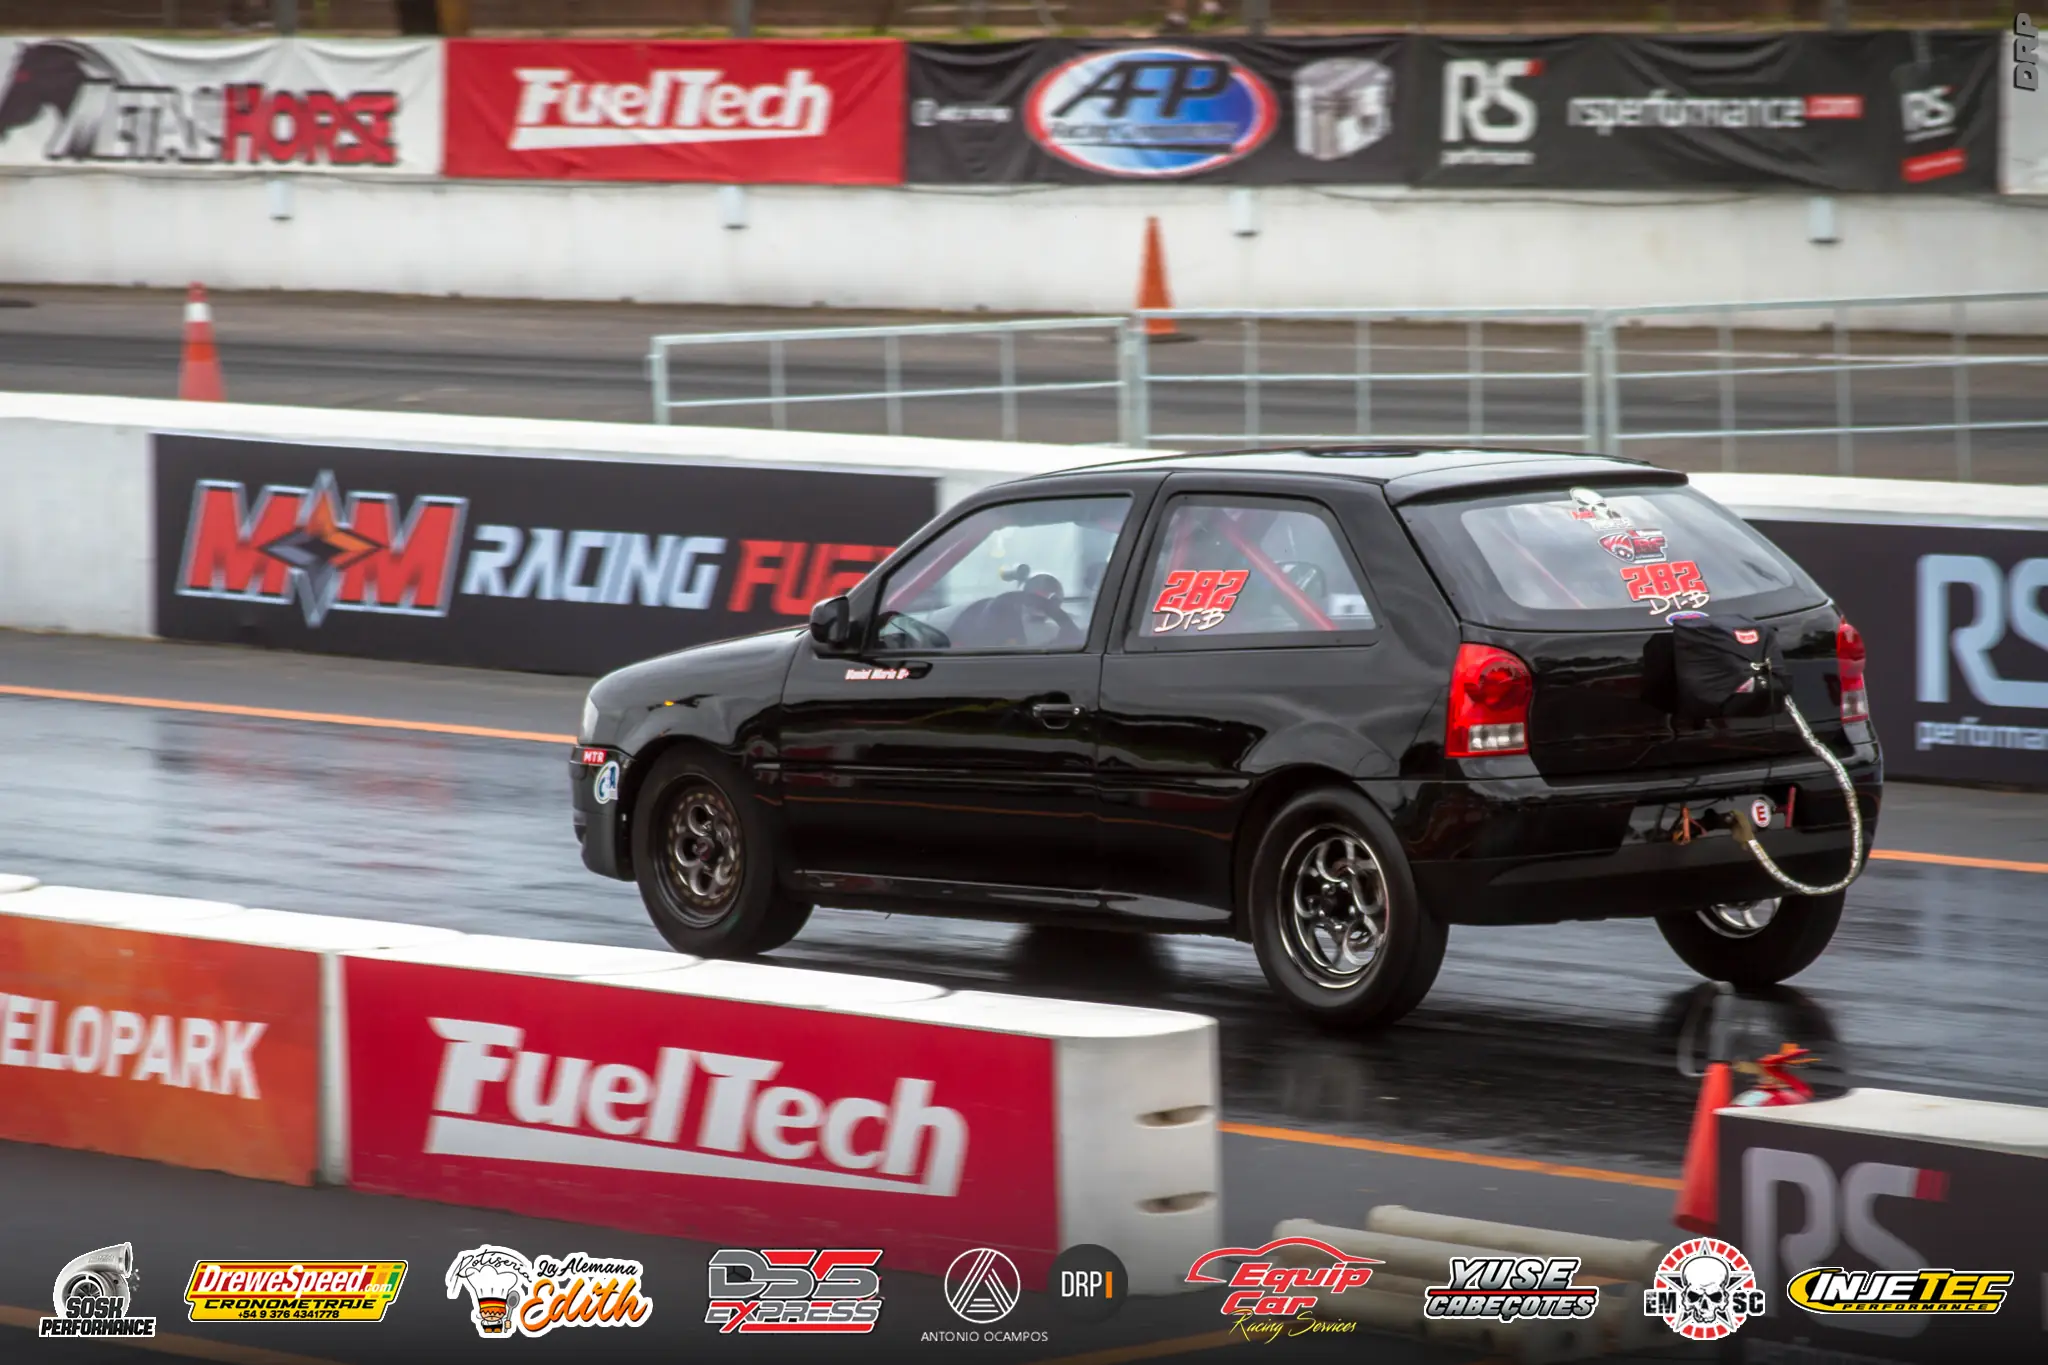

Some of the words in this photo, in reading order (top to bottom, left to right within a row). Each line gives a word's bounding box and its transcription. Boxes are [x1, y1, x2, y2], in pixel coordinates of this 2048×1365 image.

[512, 68, 831, 137] FuelTech
[1441, 58, 1545, 143] RS
[463, 525, 727, 610] RACING
[727, 539, 898, 616] FUE
[1153, 570, 1249, 612] 282
[1620, 561, 1708, 601] 282
[1154, 606, 1226, 632] DT-B
[1756, 805, 1767, 822] E
[0, 991, 268, 1100] ELOPARK
[426, 1016, 969, 1197] FuelTech
